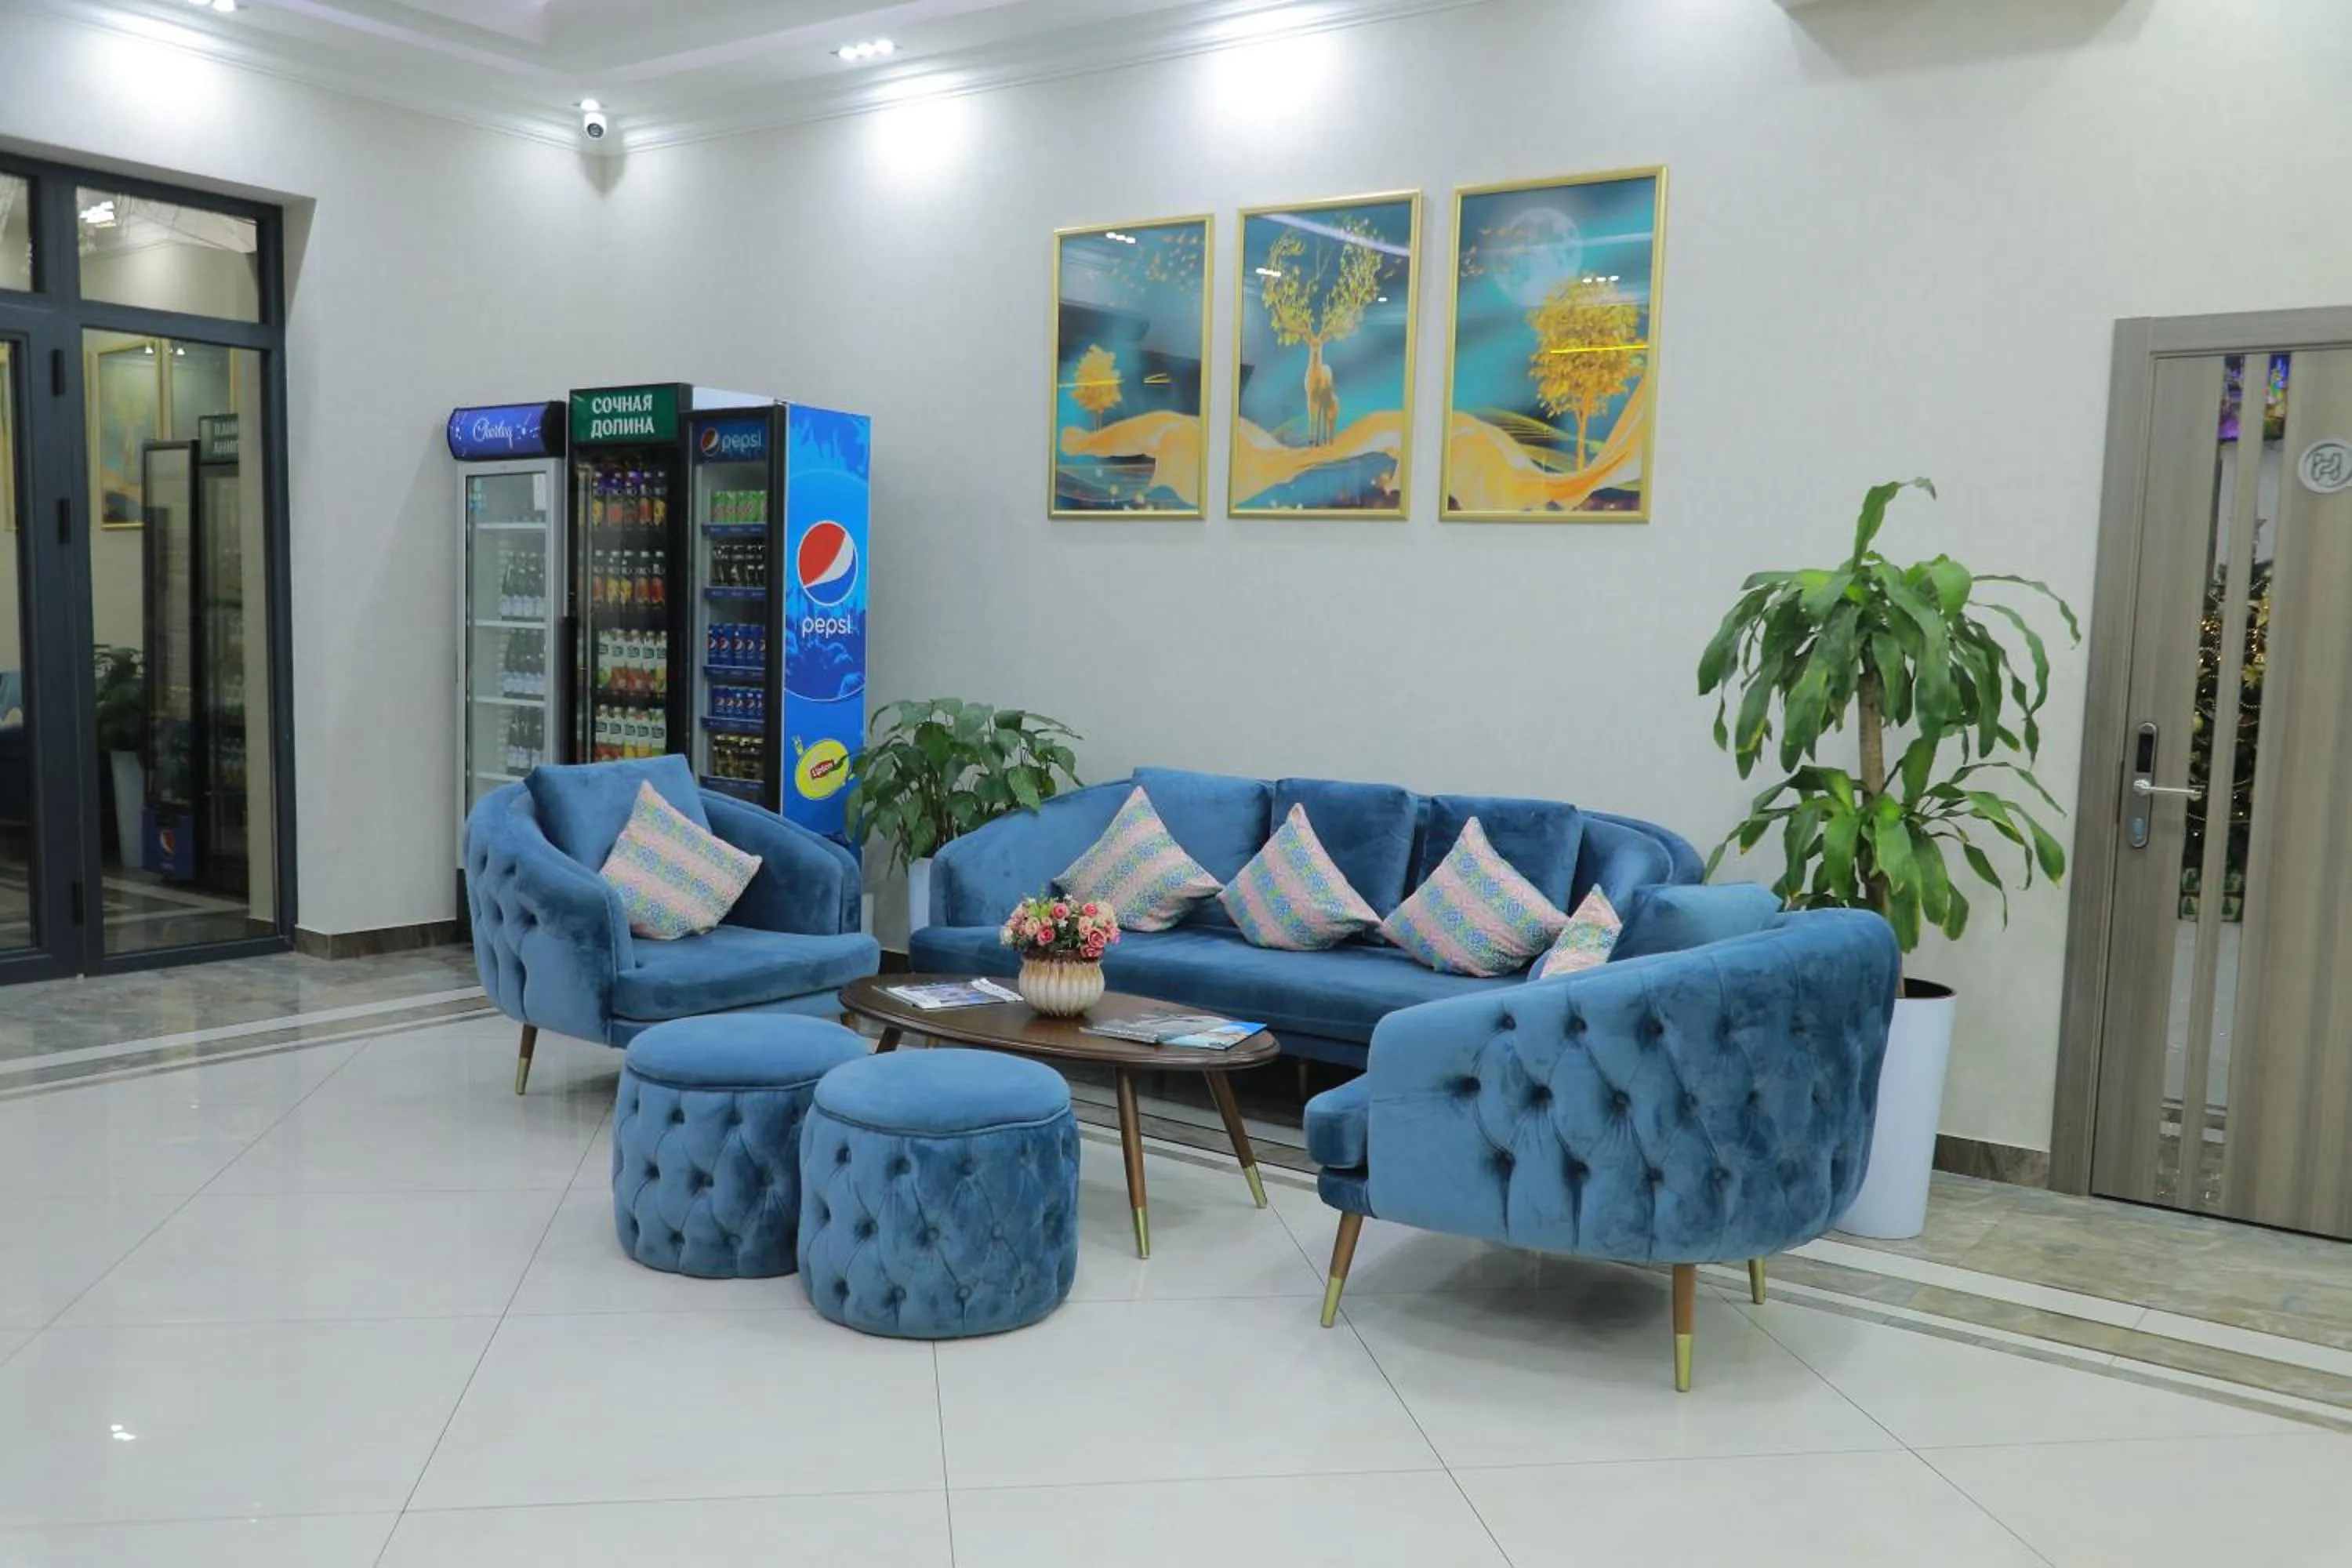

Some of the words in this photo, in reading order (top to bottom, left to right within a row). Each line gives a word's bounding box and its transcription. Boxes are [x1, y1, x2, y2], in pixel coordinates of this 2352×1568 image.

[592, 394, 653, 414] СОЧНАЯ
[590, 416, 655, 439] ДОЛИНА
[721, 429, 761, 452] pepsi
[802, 614, 851, 639] pepsi
